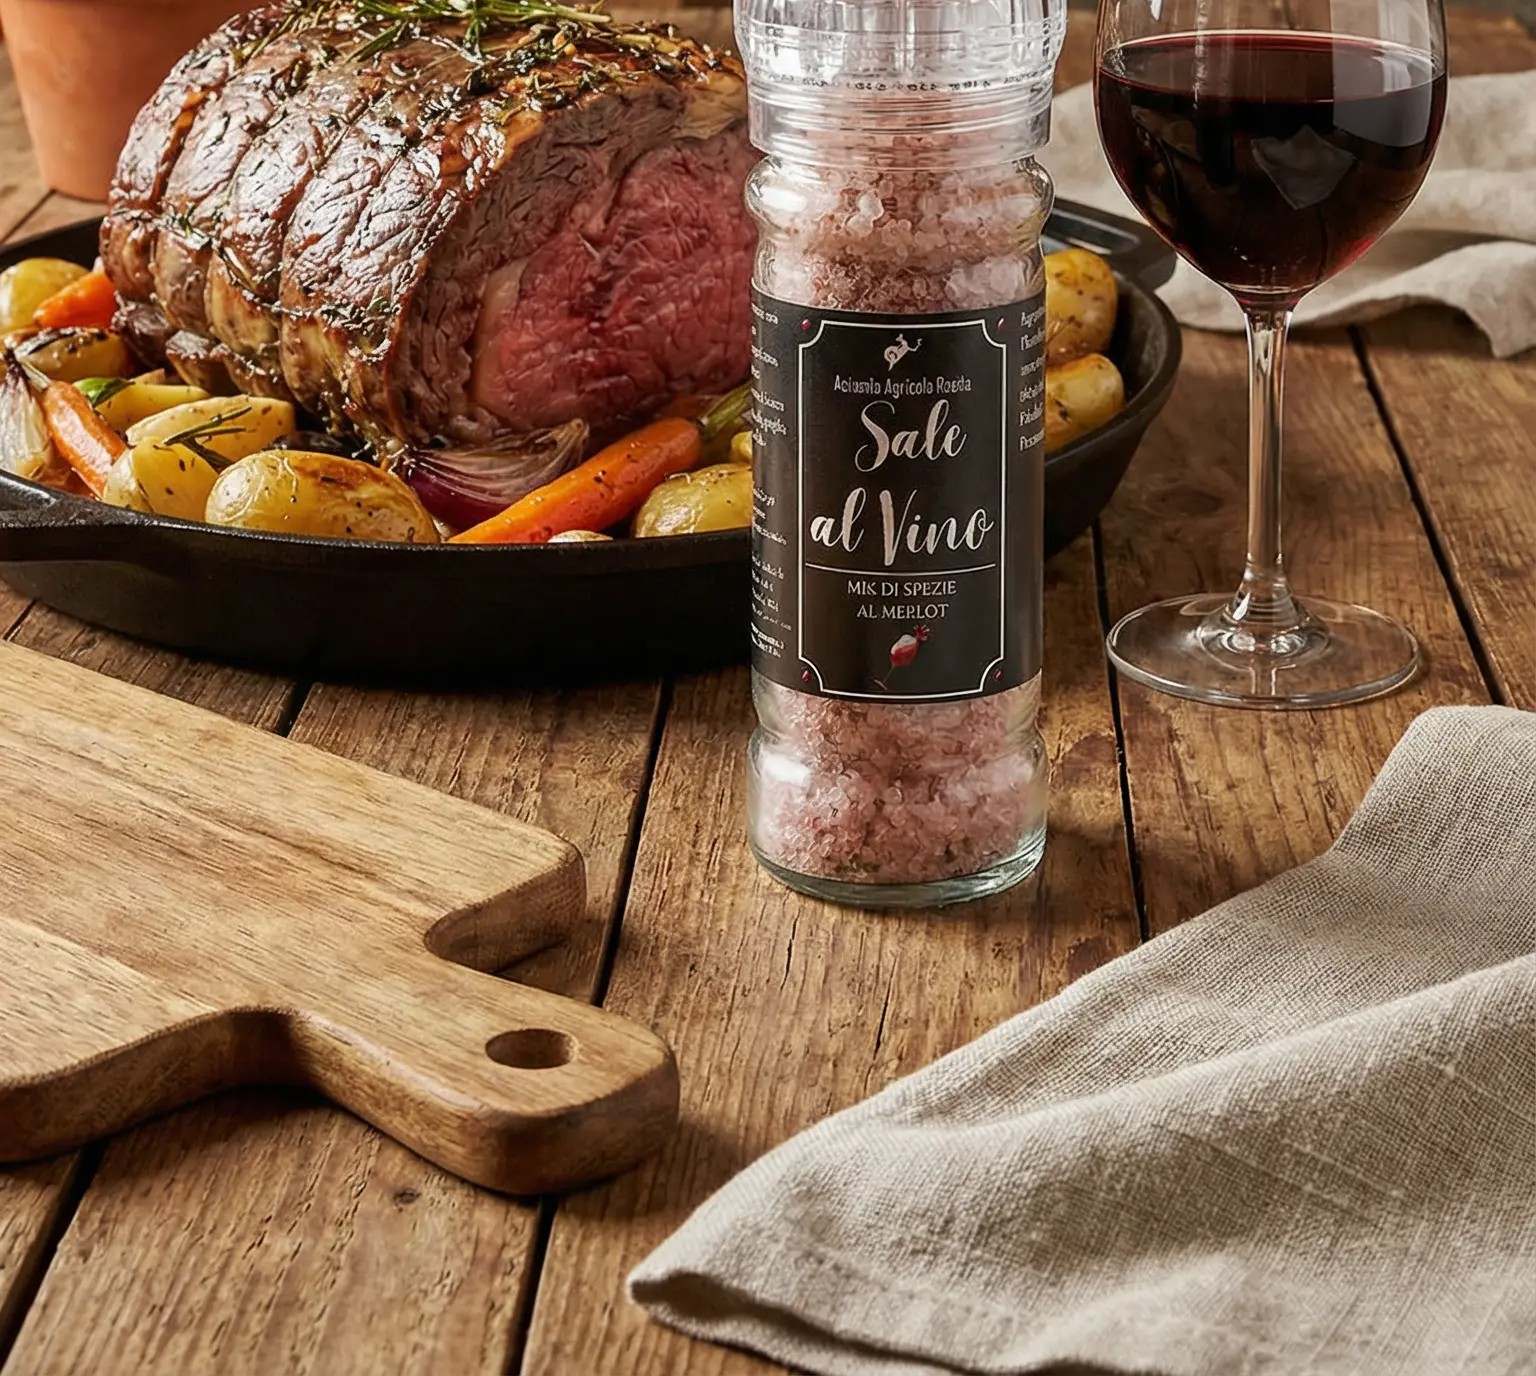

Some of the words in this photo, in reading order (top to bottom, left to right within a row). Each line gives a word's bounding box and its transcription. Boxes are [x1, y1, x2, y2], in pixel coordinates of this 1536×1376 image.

[855, 399, 967, 473] Sale
[810, 487, 867, 553] al
[879, 489, 994, 566] Vino
[857, 604, 877, 618] AL
[881, 603, 949, 619] MERLOT
[881, 582, 899, 597] DI
[903, 580, 957, 597] SPEZIE
